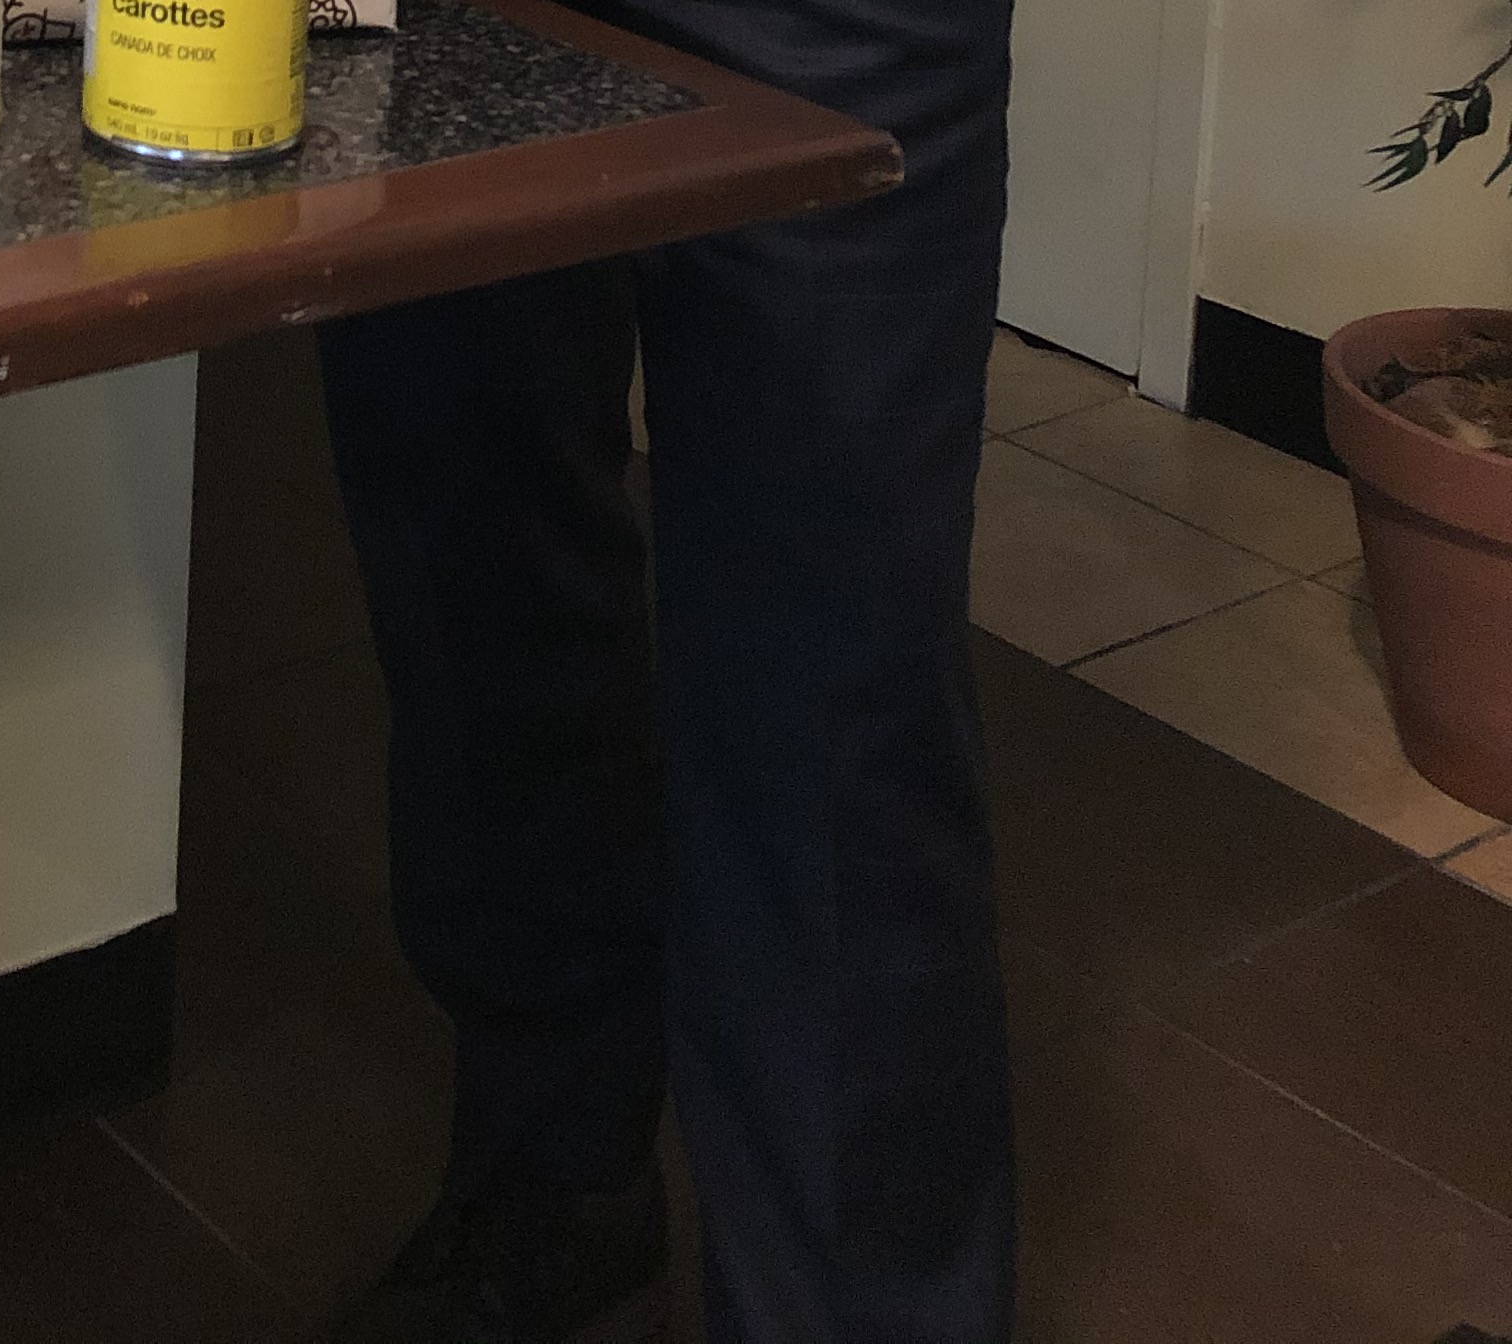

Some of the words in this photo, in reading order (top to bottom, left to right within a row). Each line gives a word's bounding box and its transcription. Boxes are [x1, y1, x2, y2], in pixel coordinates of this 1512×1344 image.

[110, 30, 154, 56] CANADA
[157, 41, 174, 58] DE
[177, 44, 216, 62] CHOIX
